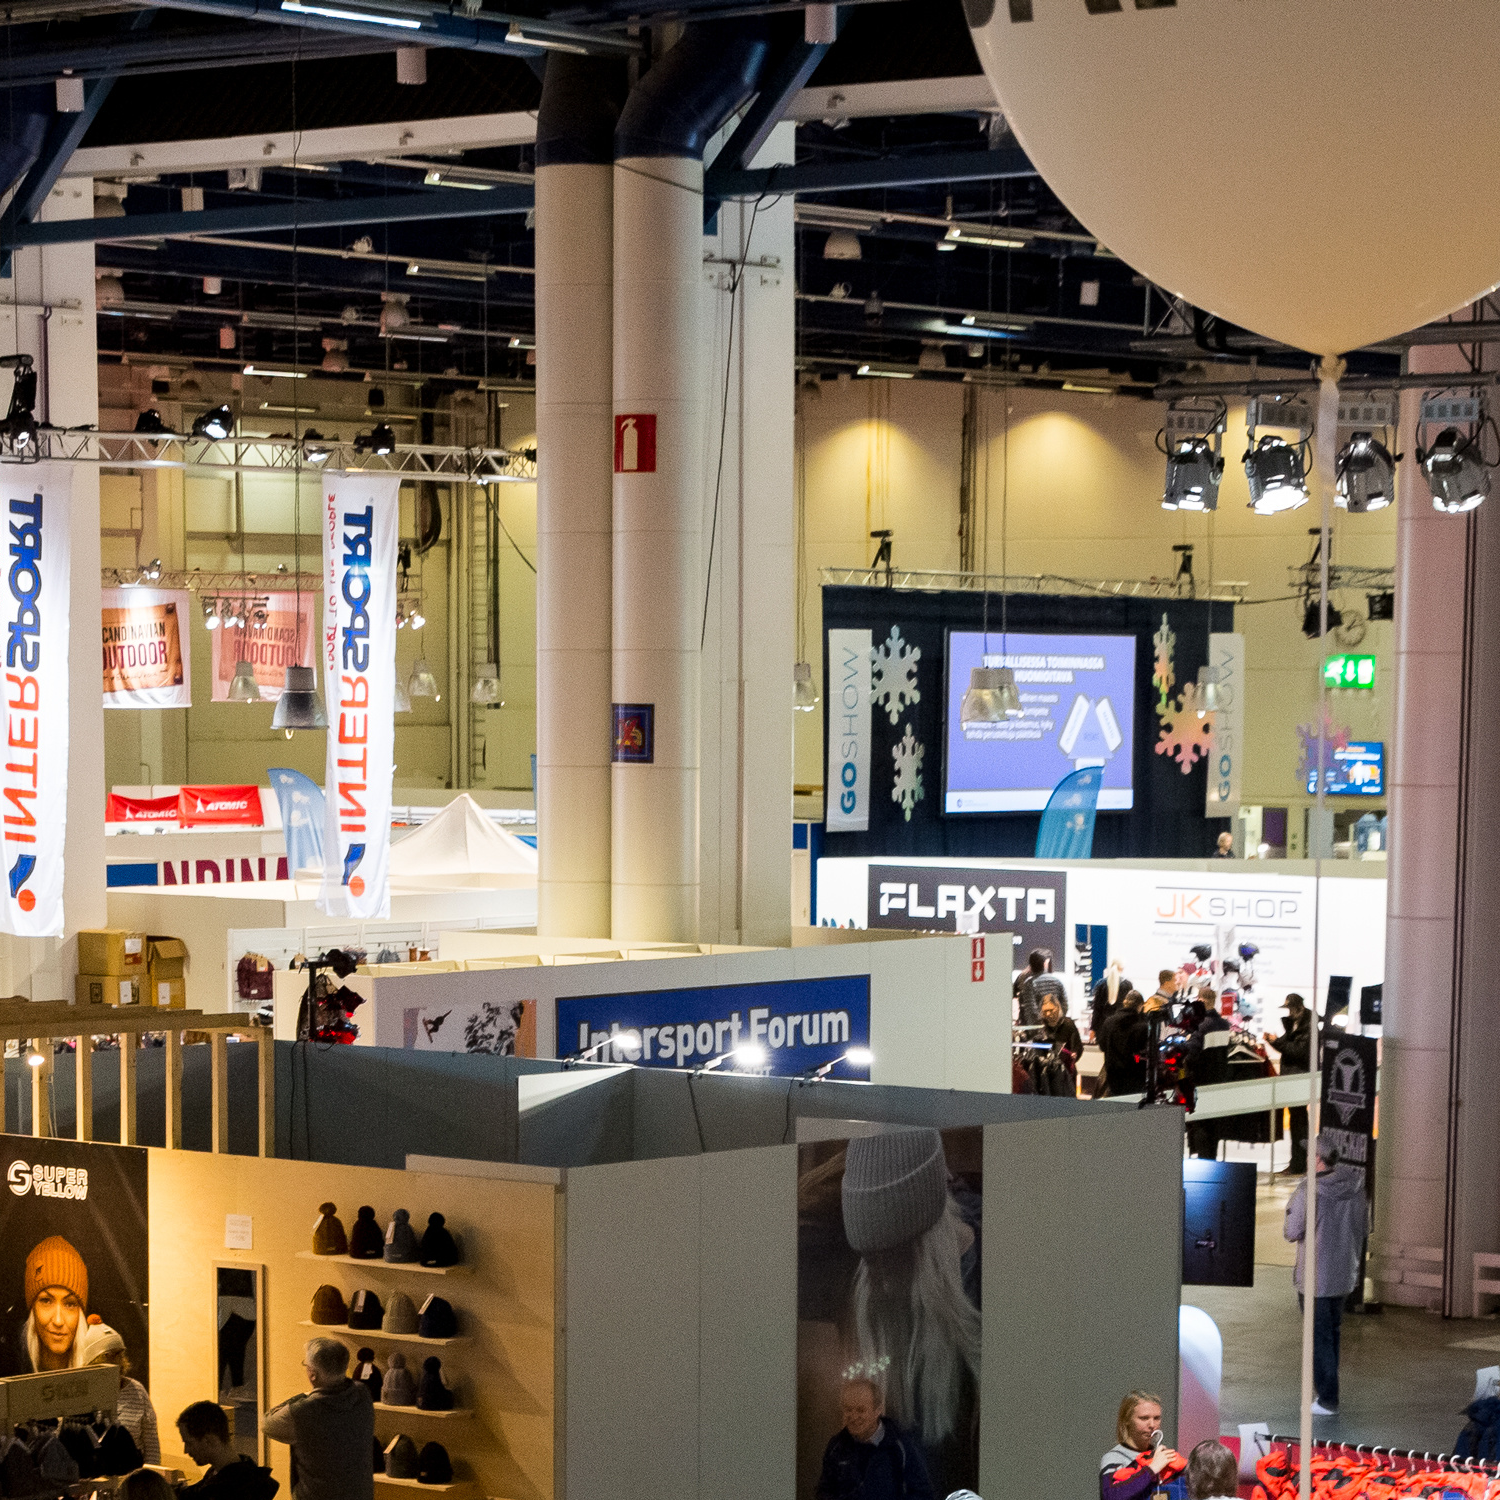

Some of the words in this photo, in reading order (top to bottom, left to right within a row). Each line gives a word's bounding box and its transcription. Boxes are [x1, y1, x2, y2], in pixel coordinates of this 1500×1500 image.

[101, 621, 166, 644] CANDINAVIAN
[840, 646, 860, 815] GOSHOW
[205, 800, 248, 812] ATOMIC
[878, 881, 1056, 922] FLAXTA
[1156, 892, 1202, 919] JK
[1208, 897, 1298, 919] SHOP
[749, 1007, 850, 1048] Forum
[32, 1163, 89, 1186] SUPER
[32, 1180, 89, 1201] YELLOW
